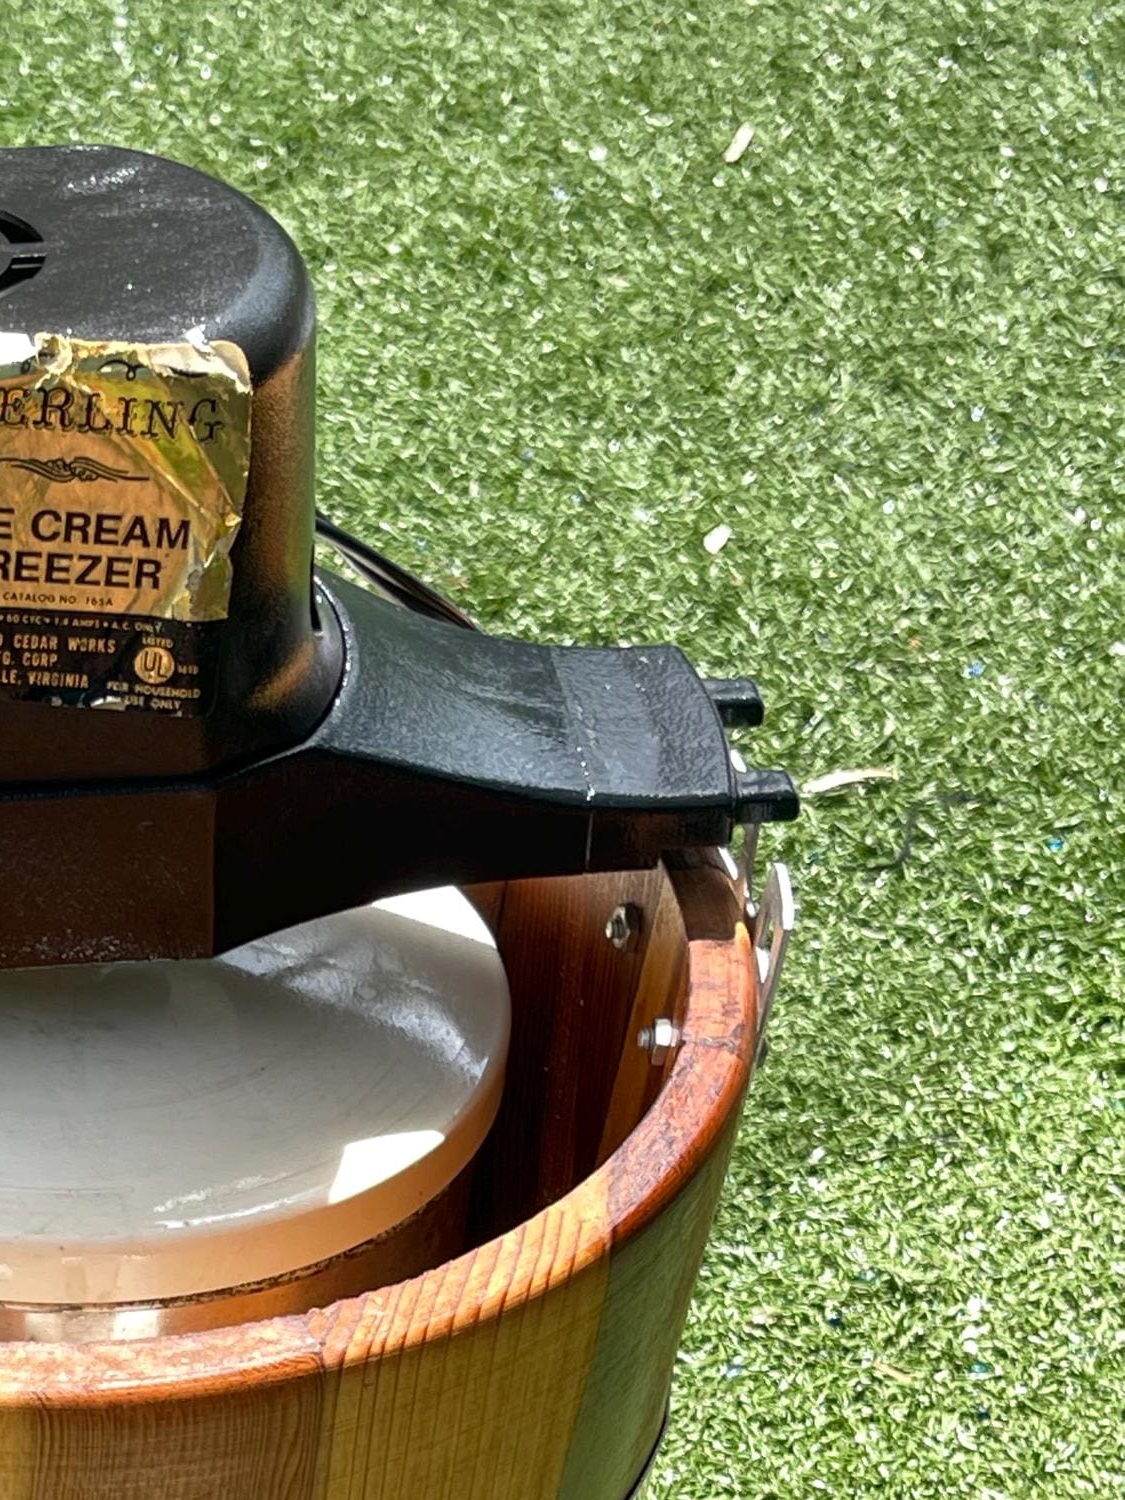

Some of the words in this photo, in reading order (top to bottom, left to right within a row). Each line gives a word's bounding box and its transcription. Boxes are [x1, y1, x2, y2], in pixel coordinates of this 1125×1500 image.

[31, 510, 190, 549] CREAM
[2, 592, 55, 604] CATALOG
[13, 634, 59, 650] CEDAR
[68, 636, 116, 654] WORKS
[27, 671, 89, 689] VIRGINIA
[106, 681, 129, 692] FOR
[135, 684, 202, 699] HOUSEHOLD
[150, 698, 182, 710] ONLY
